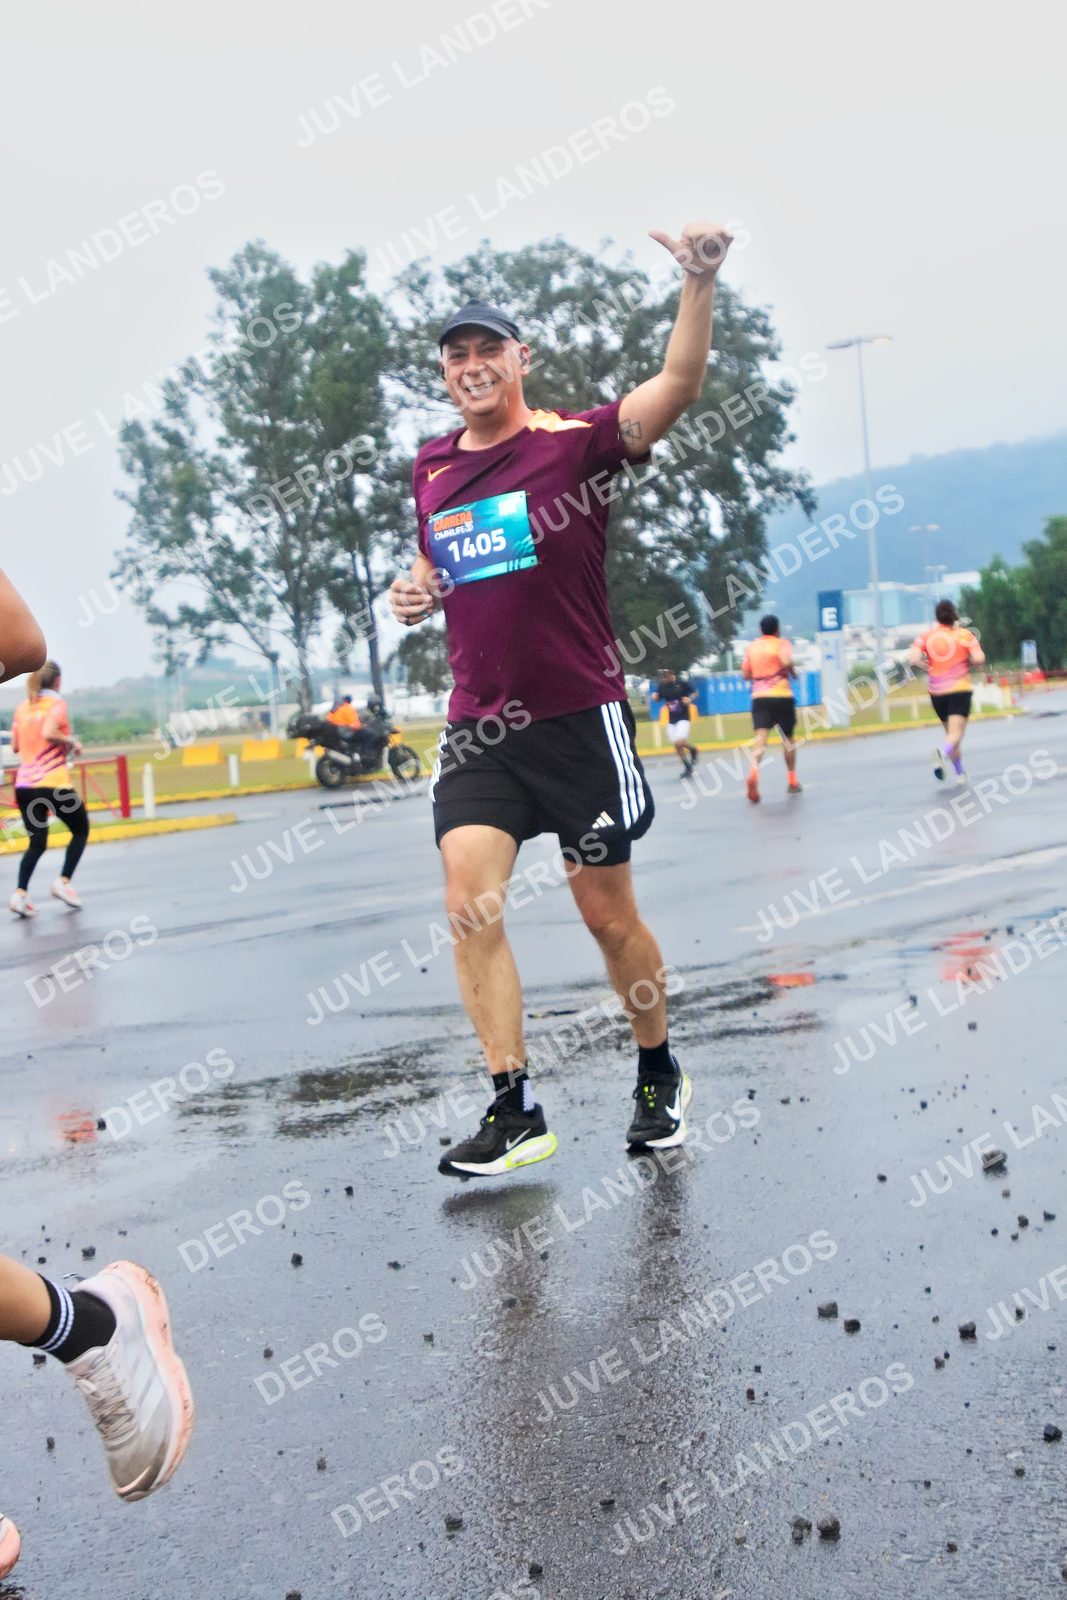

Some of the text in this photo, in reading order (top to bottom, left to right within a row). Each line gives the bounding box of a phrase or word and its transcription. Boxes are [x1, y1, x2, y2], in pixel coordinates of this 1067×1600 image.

[432, 511, 473, 532] CARRERA
[448, 528, 507, 562] 1405
[822, 607, 838, 628] E
